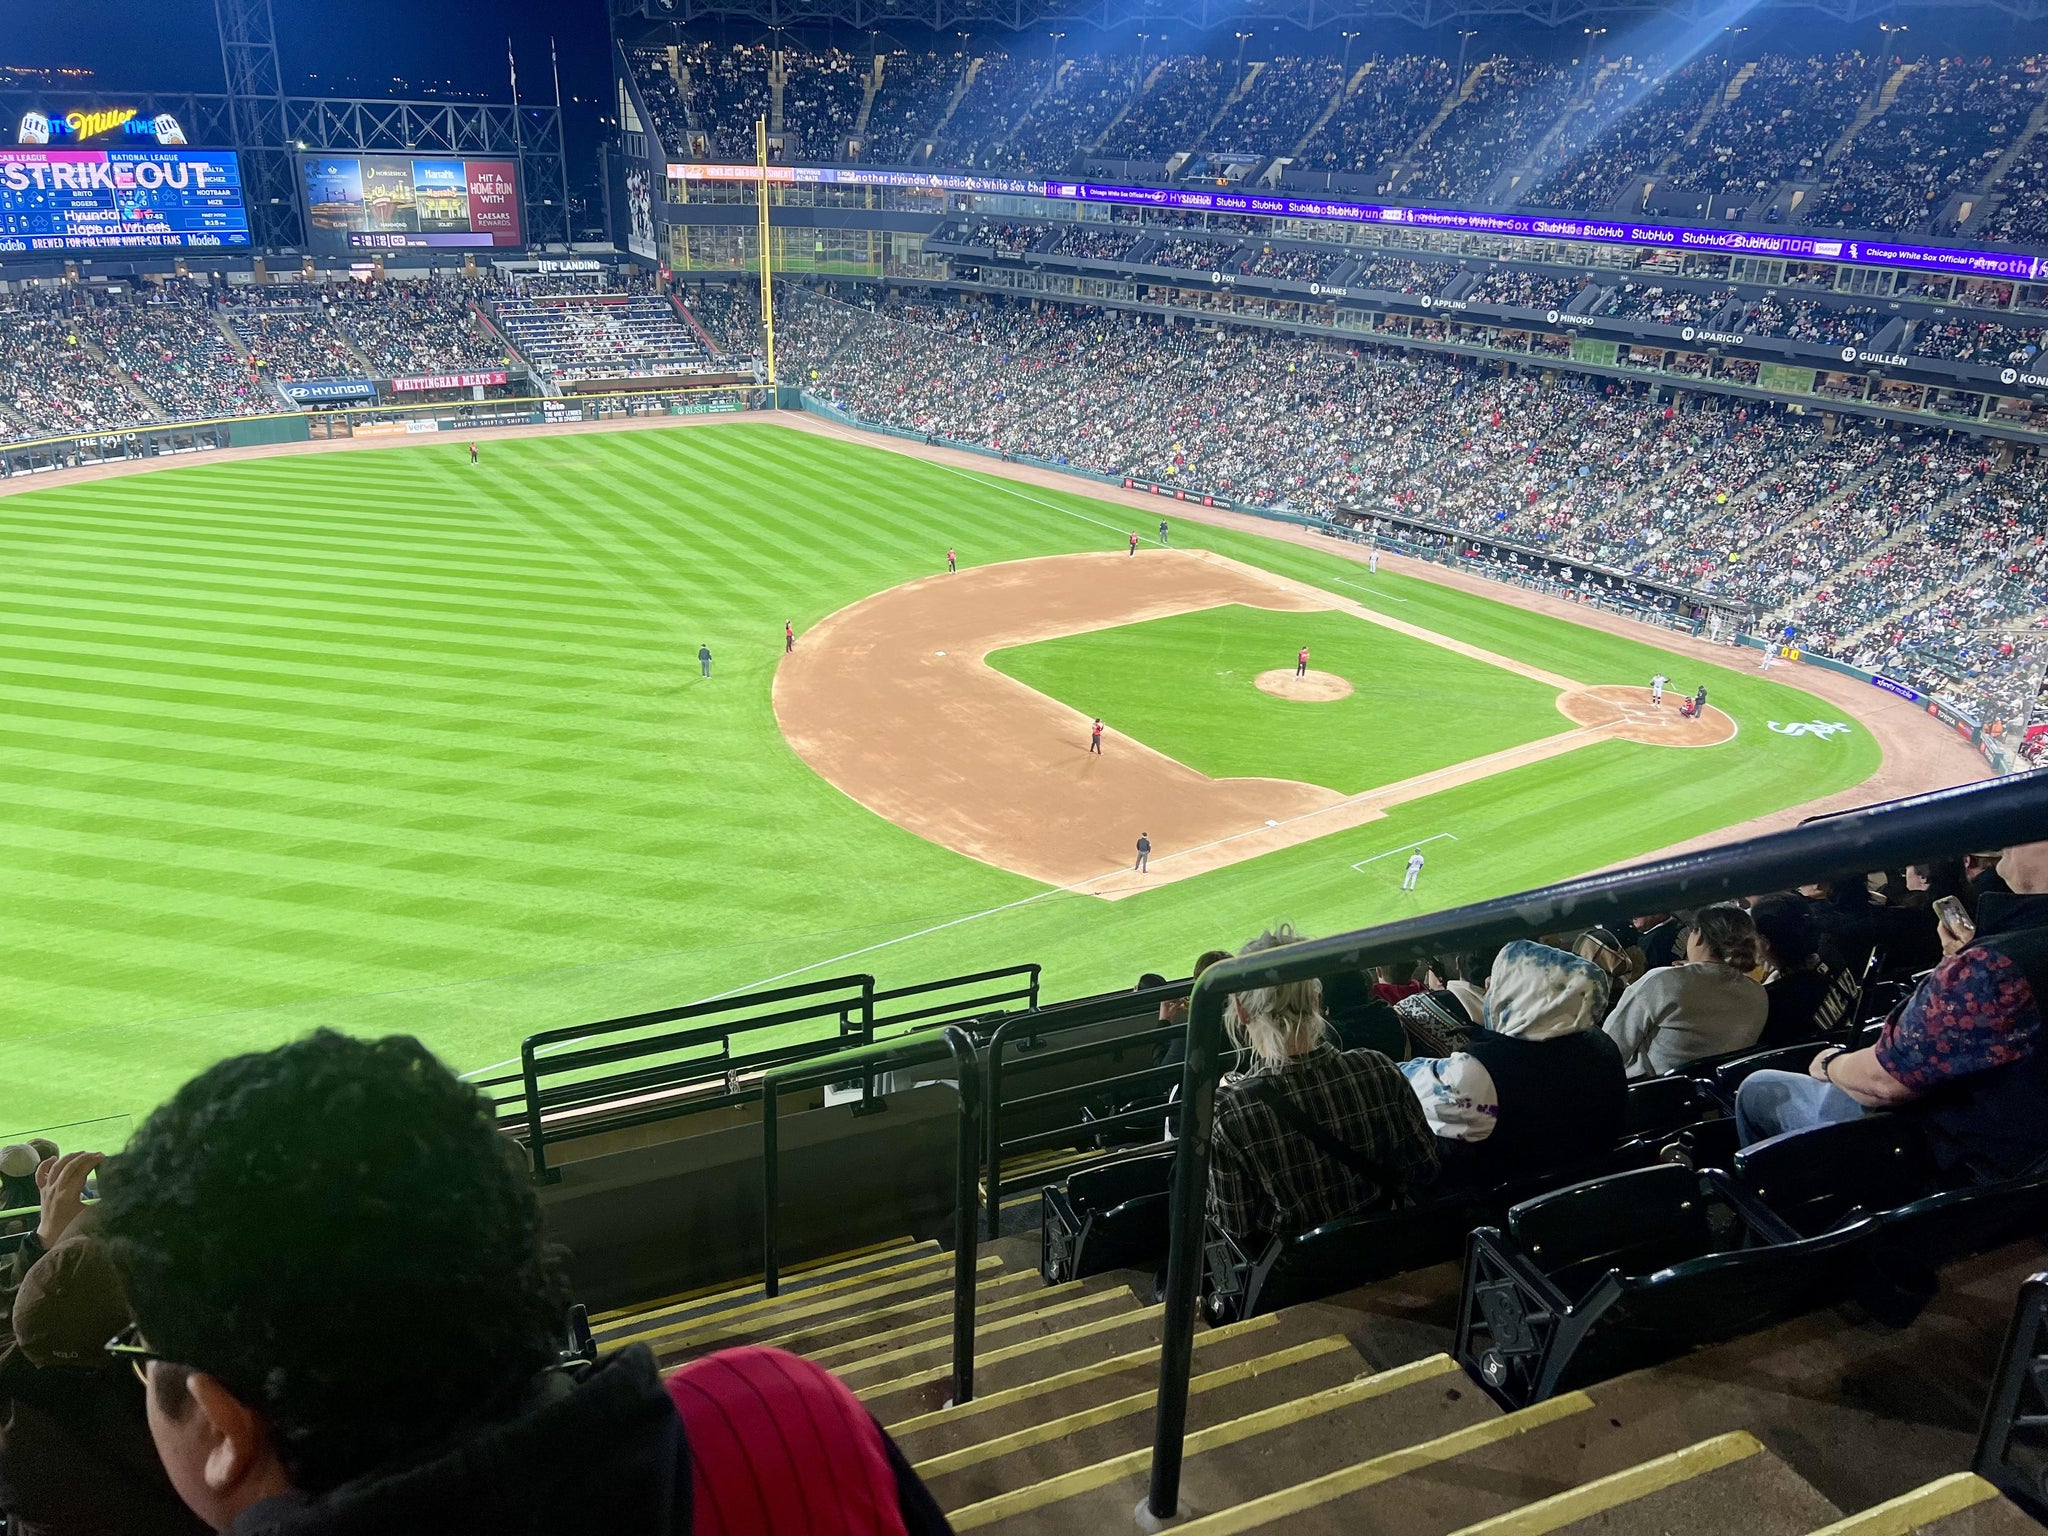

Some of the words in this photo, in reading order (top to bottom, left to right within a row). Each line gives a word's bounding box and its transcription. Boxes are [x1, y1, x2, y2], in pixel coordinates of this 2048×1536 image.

[23, 117, 47, 134] Lite
[66, 109, 137, 141] Miller
[123, 119, 157, 134] TIME
[5, 161, 210, 191] STRIKEOUT
[478, 173, 494, 182] HIT
[496, 173, 503, 182] A
[470, 183, 494, 195] HOME
[496, 183, 513, 195] RUN
[480, 195, 505, 204] WITH
[1216, 197, 1247, 208] StubHub
[1252, 200, 1284, 211] StubHub
[64, 209, 120, 222] Hyundai
[478, 219, 512, 227] REWARDS
[67, 224, 103, 236] Hope
[104, 225, 121, 233] on
[1583, 225, 1624, 238] StubHub
[1631, 228, 1674, 241] StubHub
[1681, 232, 1726, 246] StubHub
[0, 239, 26, 251] odelo
[32, 238, 64, 249] BREWED
[147, 235, 162, 246] SOX
[163, 235, 181, 246] FANS
[187, 234, 221, 246] Modelo
[1866, 248, 1897, 259] Chicago
[1898, 250, 1922, 260] White
[1922, 253, 1937, 262] Sox
[1938, 254, 1968, 265] Official
[538, 260, 557, 273] Lite
[560, 260, 600, 271] LANDING
[1222, 275, 1236, 283] FOX
[1321, 286, 1347, 296] BAINES
[1433, 299, 1467, 310] APPLING
[1560, 314, 1594, 326] MINOSO
[1696, 331, 1744, 345] APARICIO
[1859, 352, 1909, 367] GUILLÉN
[395, 376, 460, 391] WHITTINGHAM
[462, 374, 491, 386] MEATS
[312, 385, 369, 396] HYUNDAI
[685, 405, 707, 414] RUSH
[1895, 687, 1913, 699] mobile
[1937, 709, 1956, 726] TOYOTA
